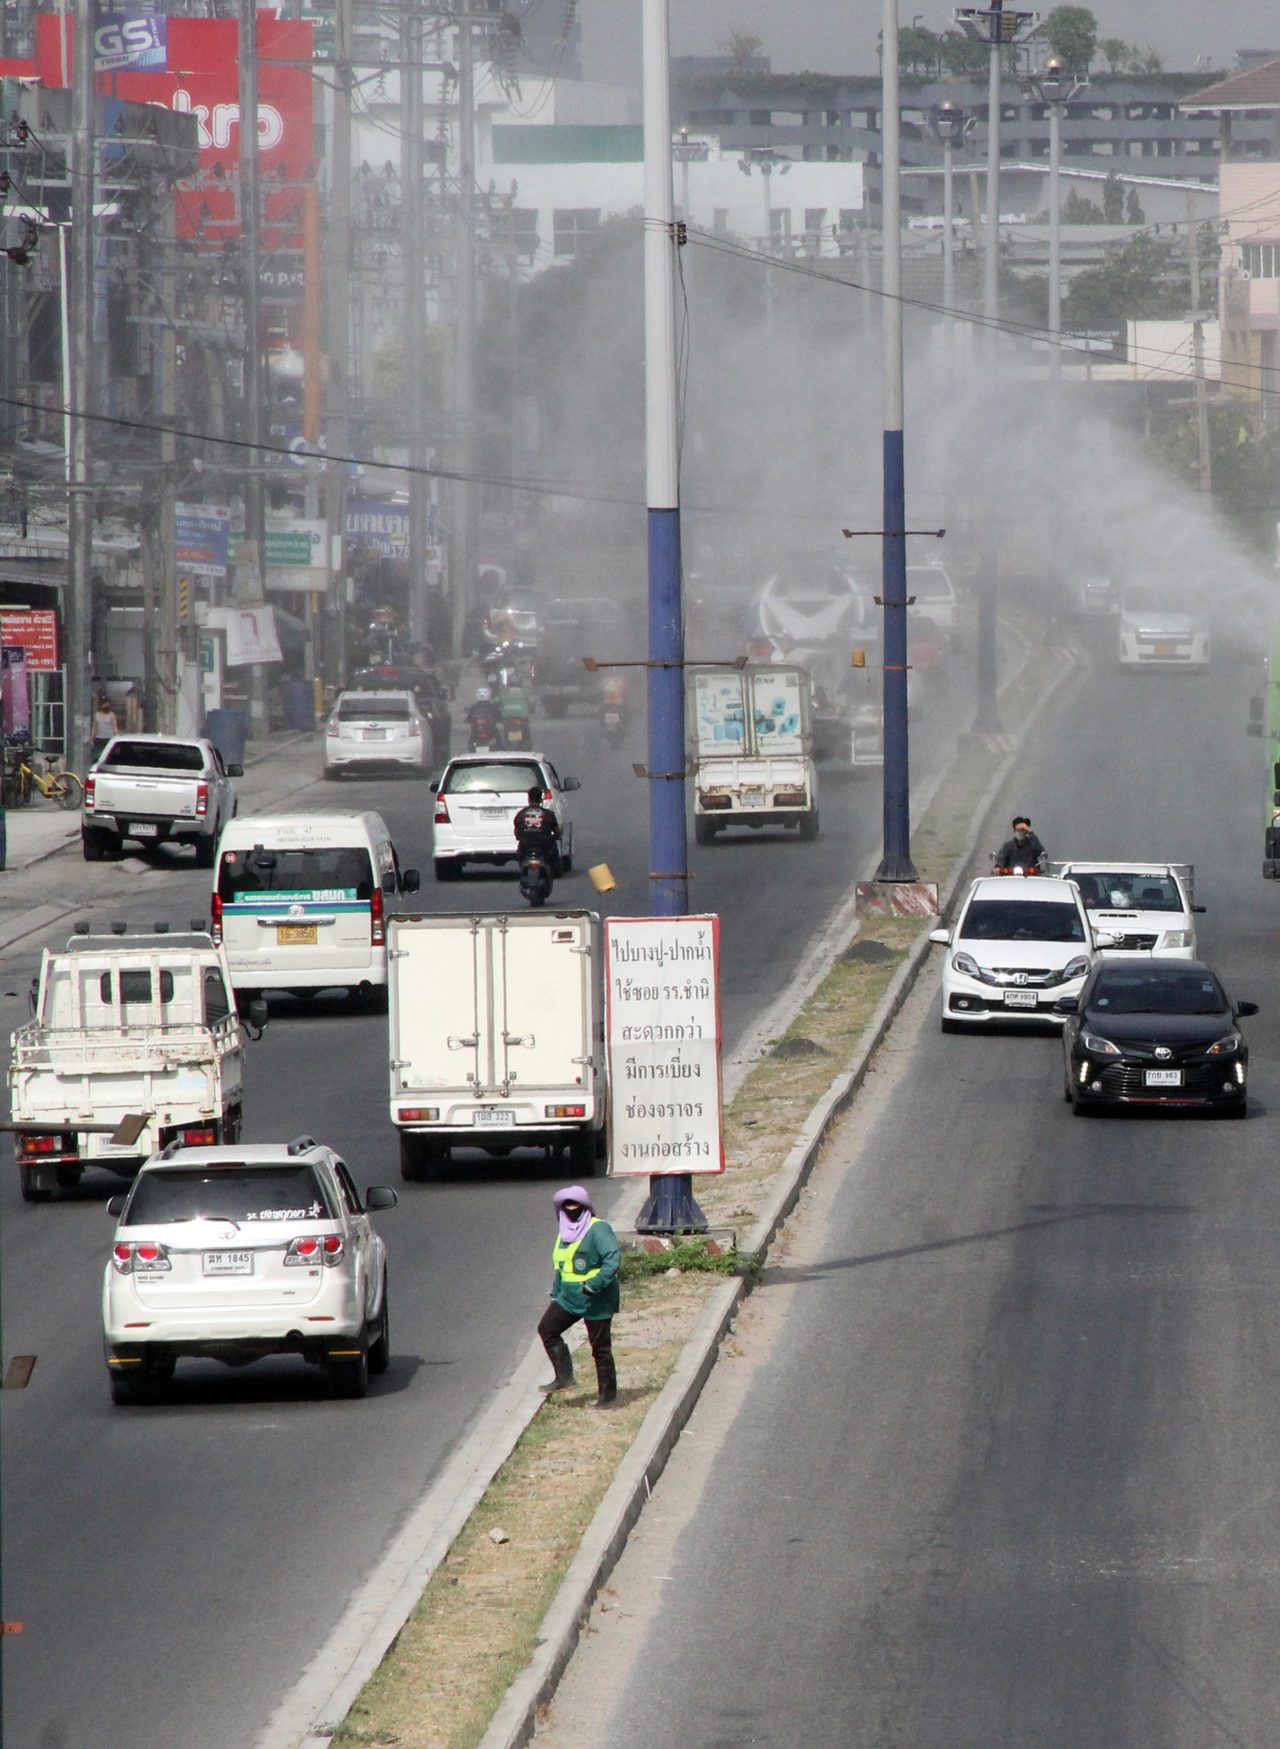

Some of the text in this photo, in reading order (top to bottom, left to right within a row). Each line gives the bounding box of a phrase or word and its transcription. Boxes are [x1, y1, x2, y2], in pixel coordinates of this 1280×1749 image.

[94, 19, 153, 56] GS
[611, 930, 712, 968] ไปบางปู-ปากน้ำ
[615, 977, 659, 1001] ใช้ซอย
[622, 1015, 703, 1042] สะดวกกว่า
[625, 1047, 701, 1079] มีการเบี่ยง
[625, 1095, 703, 1119] ช่องจราจร
[621, 1132, 710, 1158] งานก่อสร้าง
[227, 1253, 250, 1263] 1845
